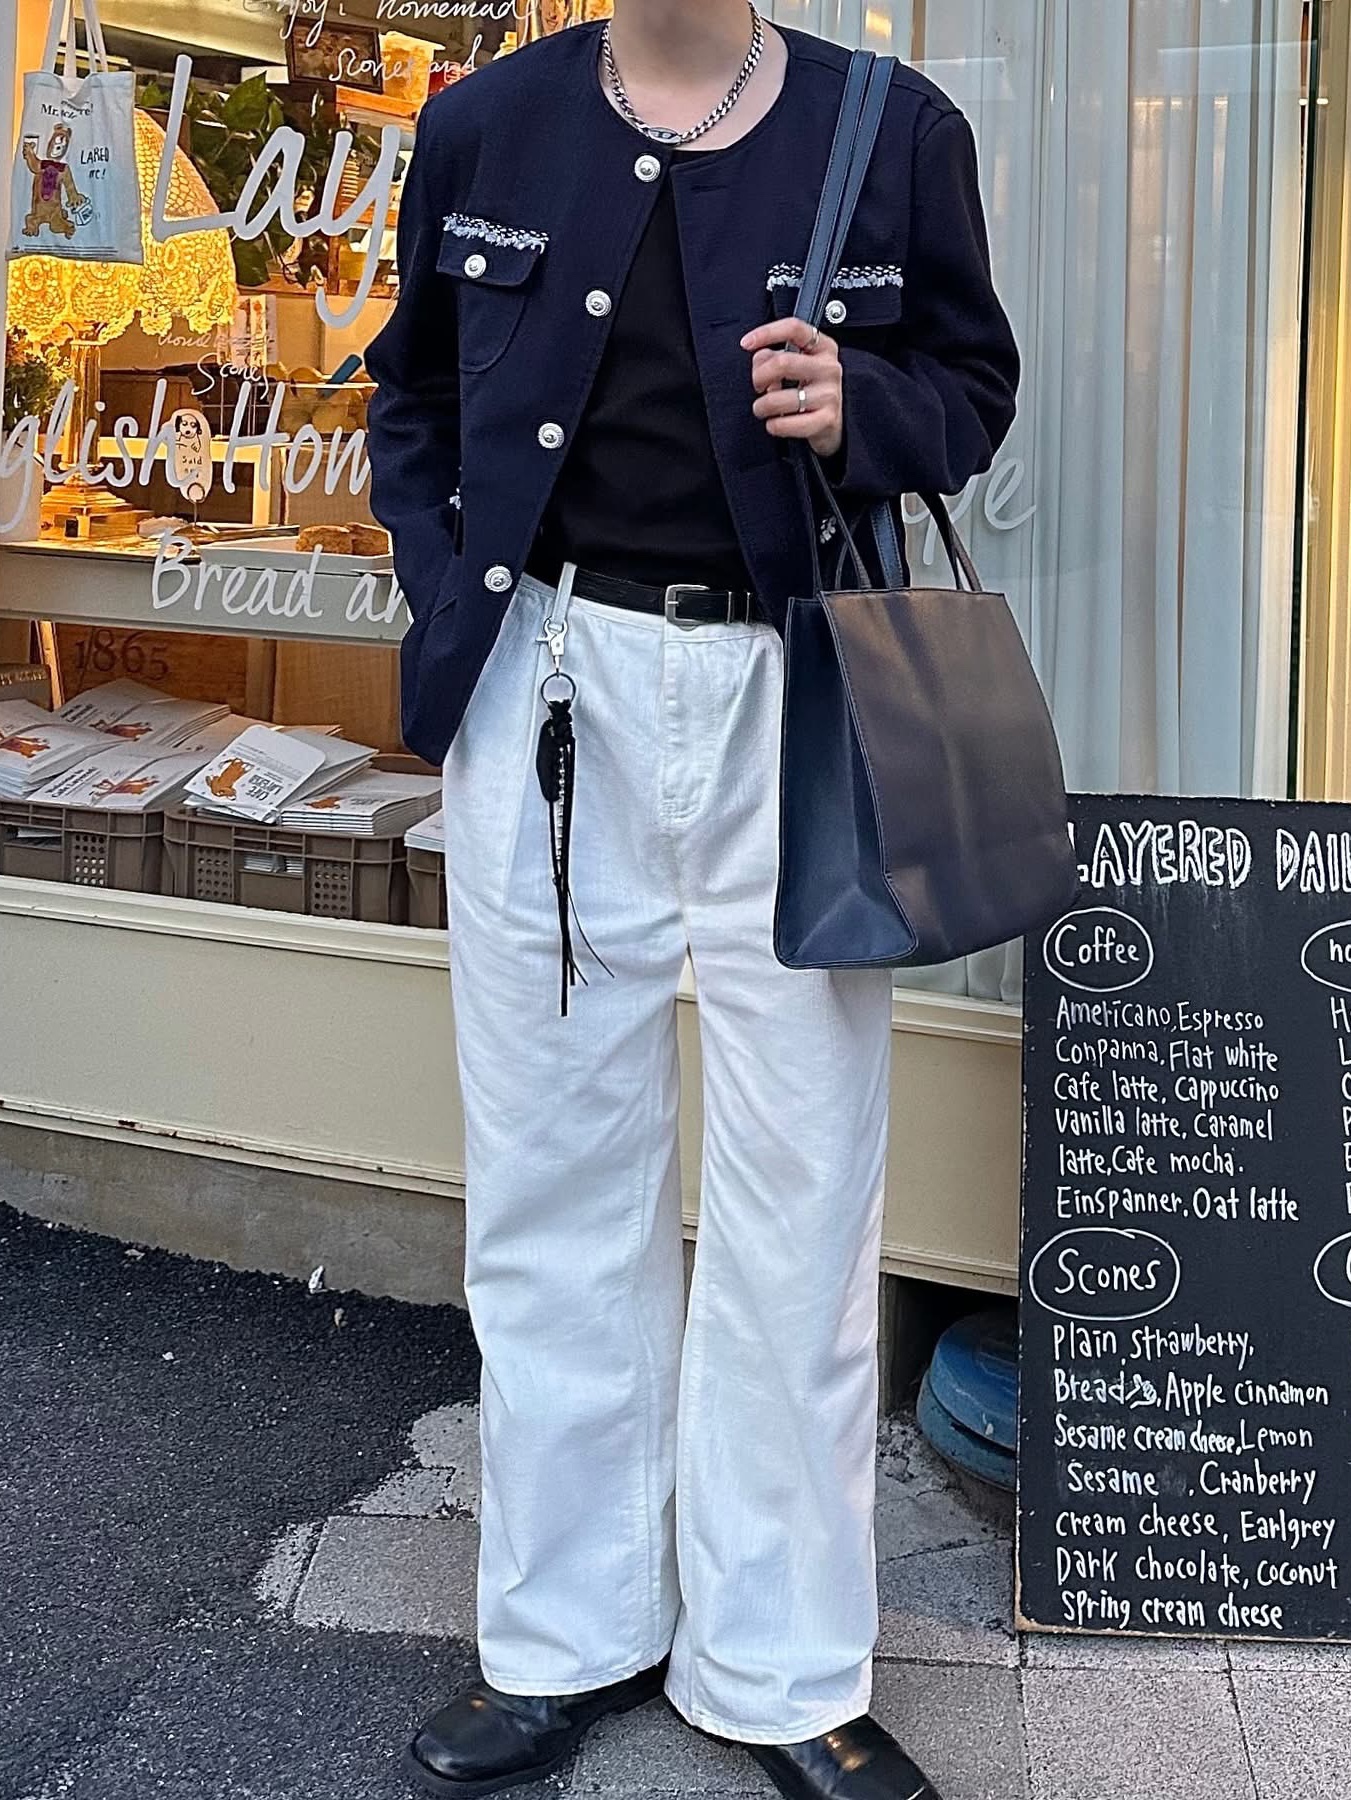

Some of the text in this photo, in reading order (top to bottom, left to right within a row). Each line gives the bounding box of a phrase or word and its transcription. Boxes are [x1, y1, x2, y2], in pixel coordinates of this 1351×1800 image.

[191, 352, 269, 400] Scones
[152, 529, 323, 613] Bread
[1054, 923, 1140, 969] Coffee
[1177, 1002, 1263, 1037] Espresso
[1170, 1040, 1214, 1071] Flat
[1225, 1038, 1277, 1071] white
[1055, 1070, 1278, 1110] Cafe latte, Cappuccino
[1056, 1105, 1272, 1140] Vanilla latte, Caramel
[1112, 1145, 1157, 1175] Cafe
[1170, 1144, 1243, 1176] mocha.
[1193, 1188, 1239, 1219] Oat
[1250, 1187, 1298, 1220] latte
[1054, 1247, 1160, 1296] Scones
[1165, 1372, 1225, 1416] Apple
[1235, 1380, 1328, 1406] cinnamon
[1055, 1413, 1126, 1450] Sesame
[1134, 1426, 1185, 1451] cream
[1241, 1419, 1312, 1451] Lemon
[1068, 1458, 1315, 1504] Sesame Cranberry
[1056, 1503, 1335, 1549] cream cheese, Earlgrey
[1057, 1546, 1337, 1589] Dark chocolate, coconut
[1142, 1598, 1205, 1626] cream
[1218, 1592, 1282, 1629] cheese
